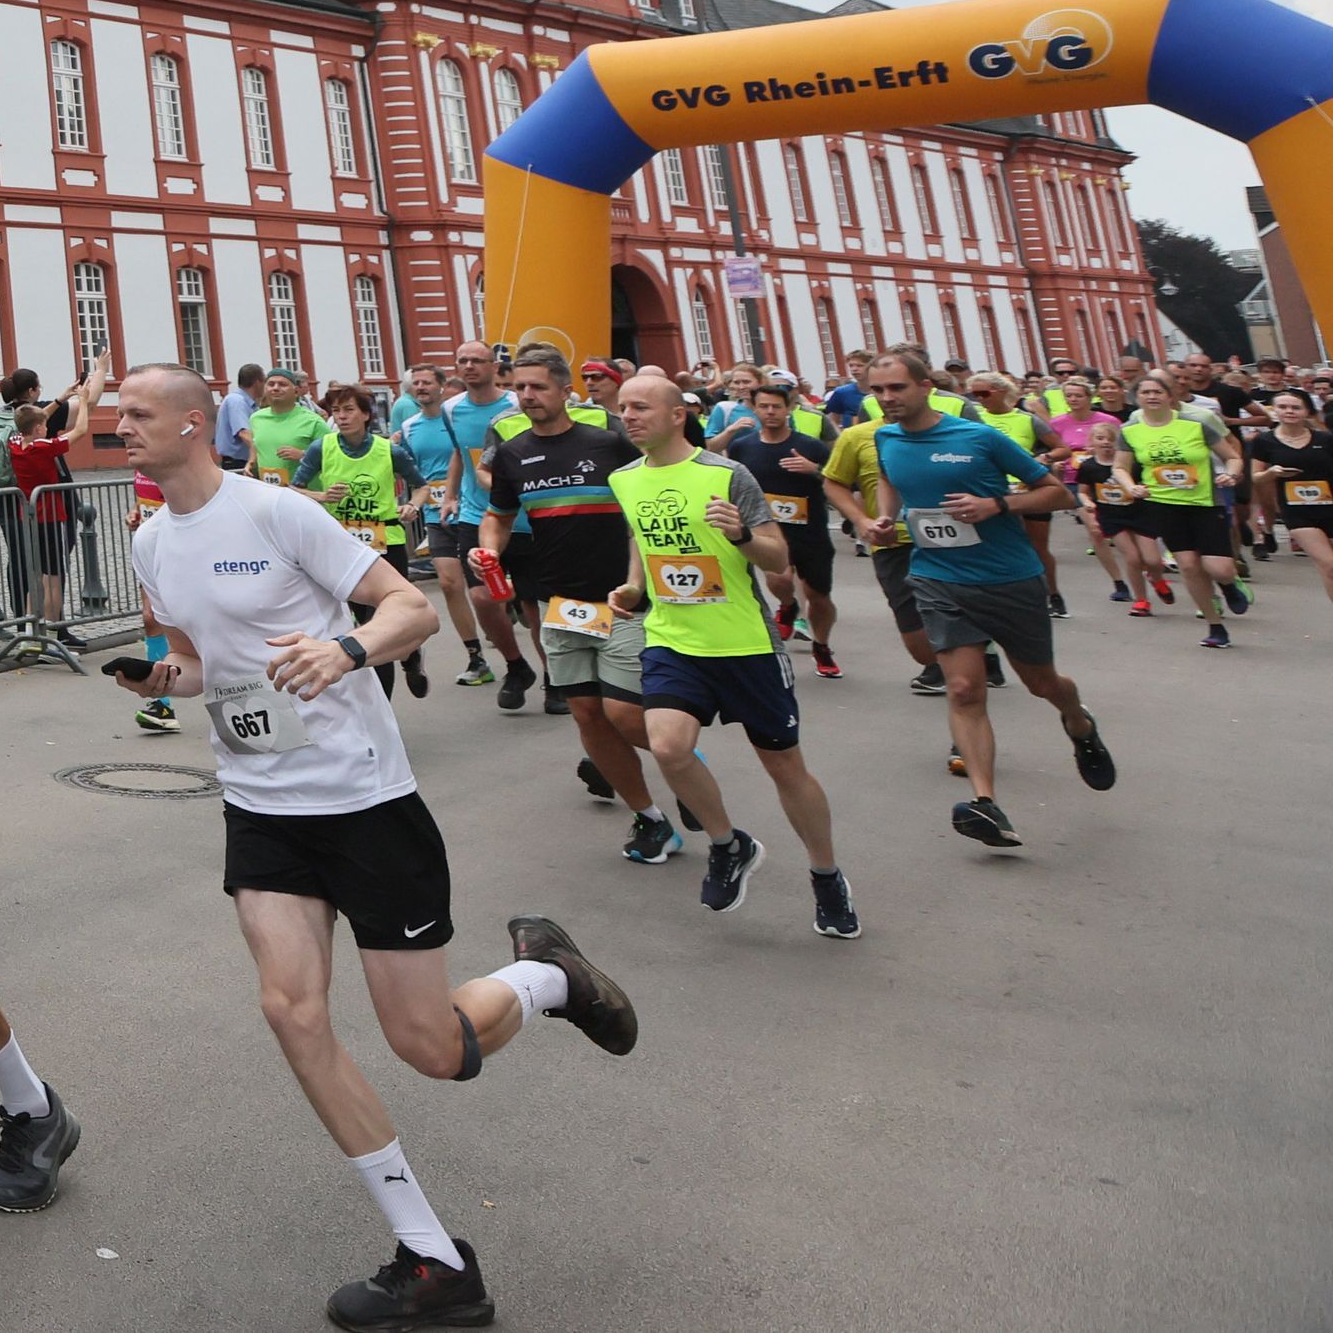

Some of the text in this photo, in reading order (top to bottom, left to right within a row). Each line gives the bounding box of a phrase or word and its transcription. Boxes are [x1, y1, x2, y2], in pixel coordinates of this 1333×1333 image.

[966, 32, 1094, 81] GVG
[651, 60, 949, 112] GVG Rhein-Erft
[635, 495, 680, 518] GVG
[777, 505, 792, 514] 72
[637, 517, 689, 532] LAUF
[924, 524, 958, 539] 670
[352, 532, 372, 542] 12
[643, 533, 696, 547] TEAM
[666, 573, 699, 587] 127
[568, 608, 587, 620] 43
[223, 680, 264, 696] DREAM BIG
[231, 709, 271, 739] 667
